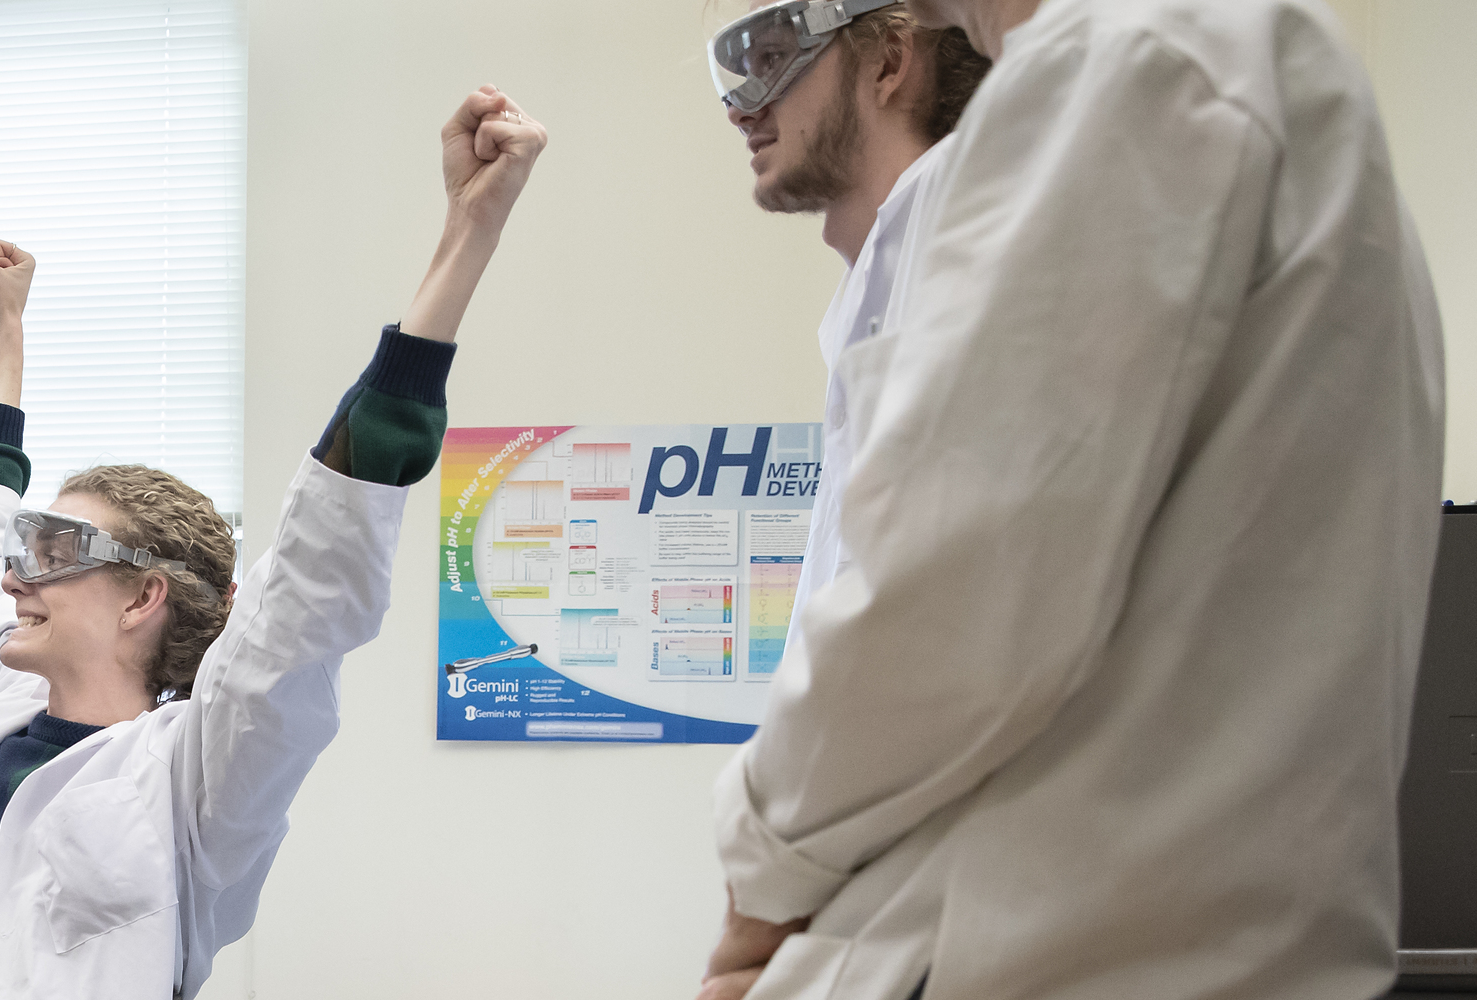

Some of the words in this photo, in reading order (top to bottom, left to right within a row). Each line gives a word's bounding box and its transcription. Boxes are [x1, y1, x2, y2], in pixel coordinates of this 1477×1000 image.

[477, 428, 535, 478] Selectivity
[638, 426, 773, 514] pH
[457, 477, 480, 511] Alter
[450, 511, 463, 525] to
[447, 527, 459, 548] pH
[445, 550, 464, 593] Adjust
[651, 590, 659, 616] Acids
[651, 642, 659, 670] Bases
[466, 678, 519, 693] Gemini
[495, 694, 519, 703] pH-LC
[475, 709, 522, 718] Gemini-NX
